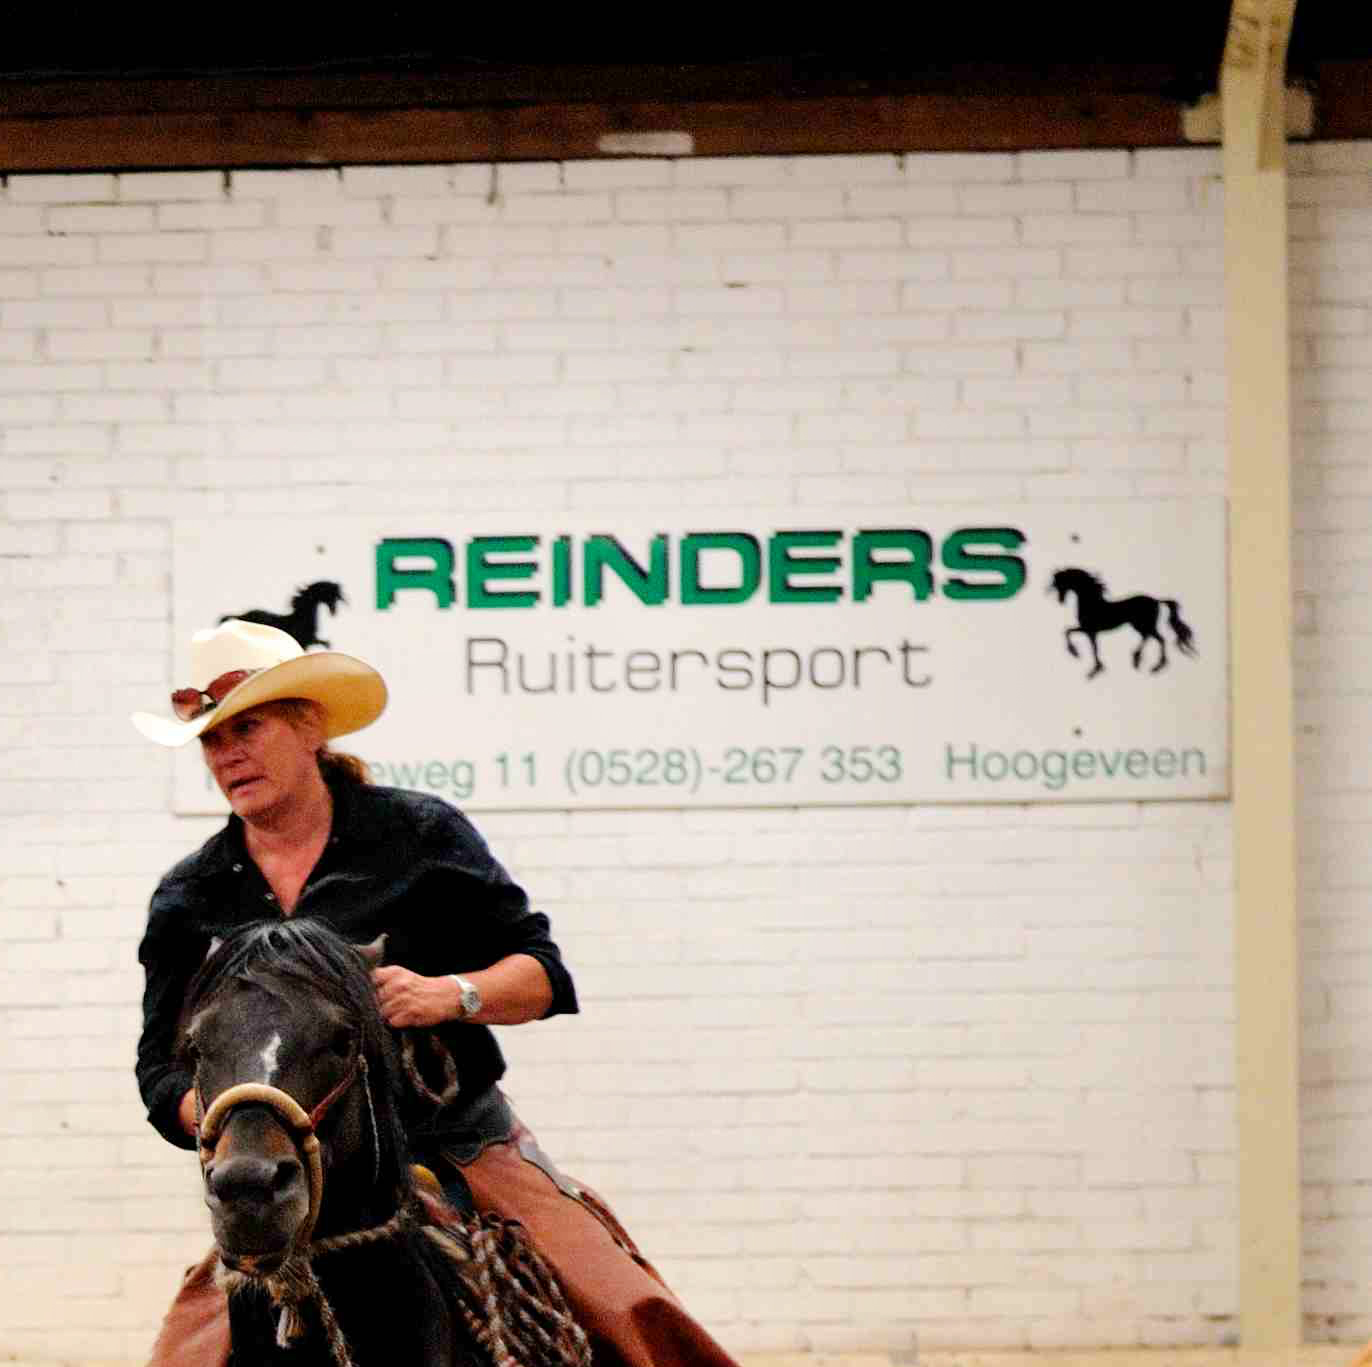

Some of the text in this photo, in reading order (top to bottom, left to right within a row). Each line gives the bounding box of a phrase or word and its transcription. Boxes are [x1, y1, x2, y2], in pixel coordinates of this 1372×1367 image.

[374, 526, 1028, 610] REINDERS
[464, 636, 934, 707] Ruitersport
[494, 753, 536, 787] 11
[564, 747, 804, 795] (0528)-267
[819, 744, 903, 785] 353
[944, 742, 1208, 791] Hoogeveen
